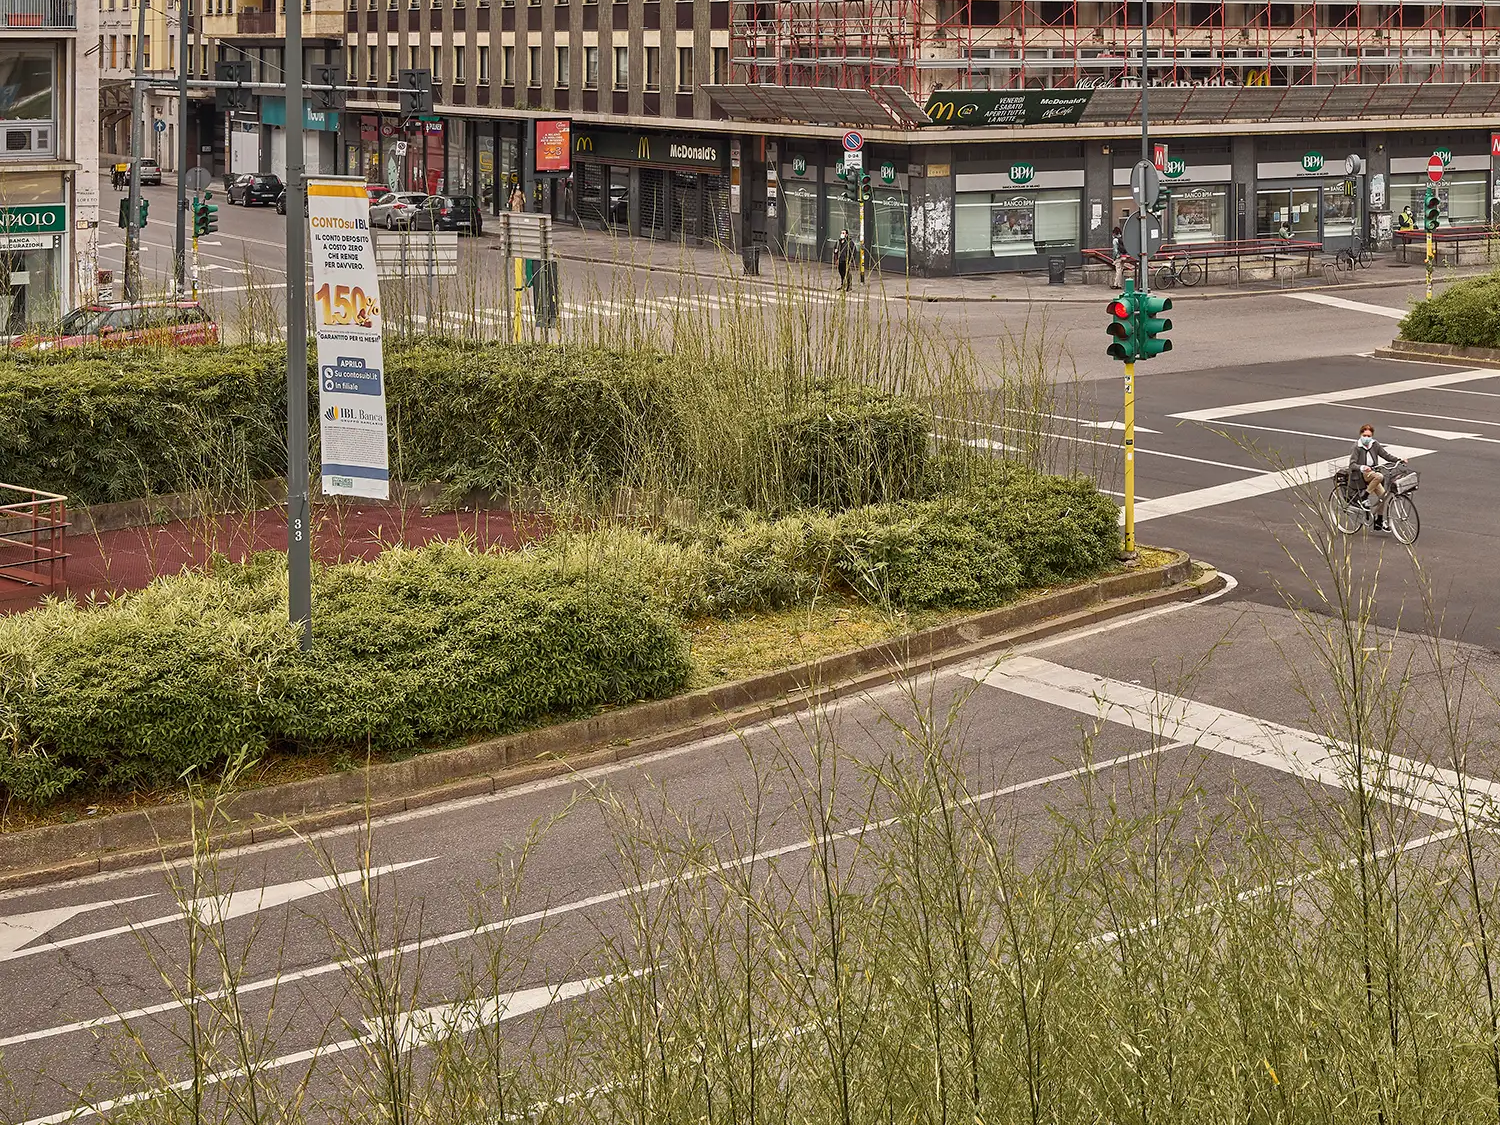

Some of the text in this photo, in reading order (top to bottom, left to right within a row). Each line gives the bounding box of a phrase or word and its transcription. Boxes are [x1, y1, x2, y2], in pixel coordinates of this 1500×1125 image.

[1040, 97, 1087, 105] McDonald's
[670, 144, 716, 162] McDonald's
[1155, 151, 1164, 165] M
[1304, 156, 1323, 168] BPM
[1010, 166, 1034, 179] BPM
[341, 360, 362, 368] APRILO
[341, 408, 383, 421] IBL Banca
